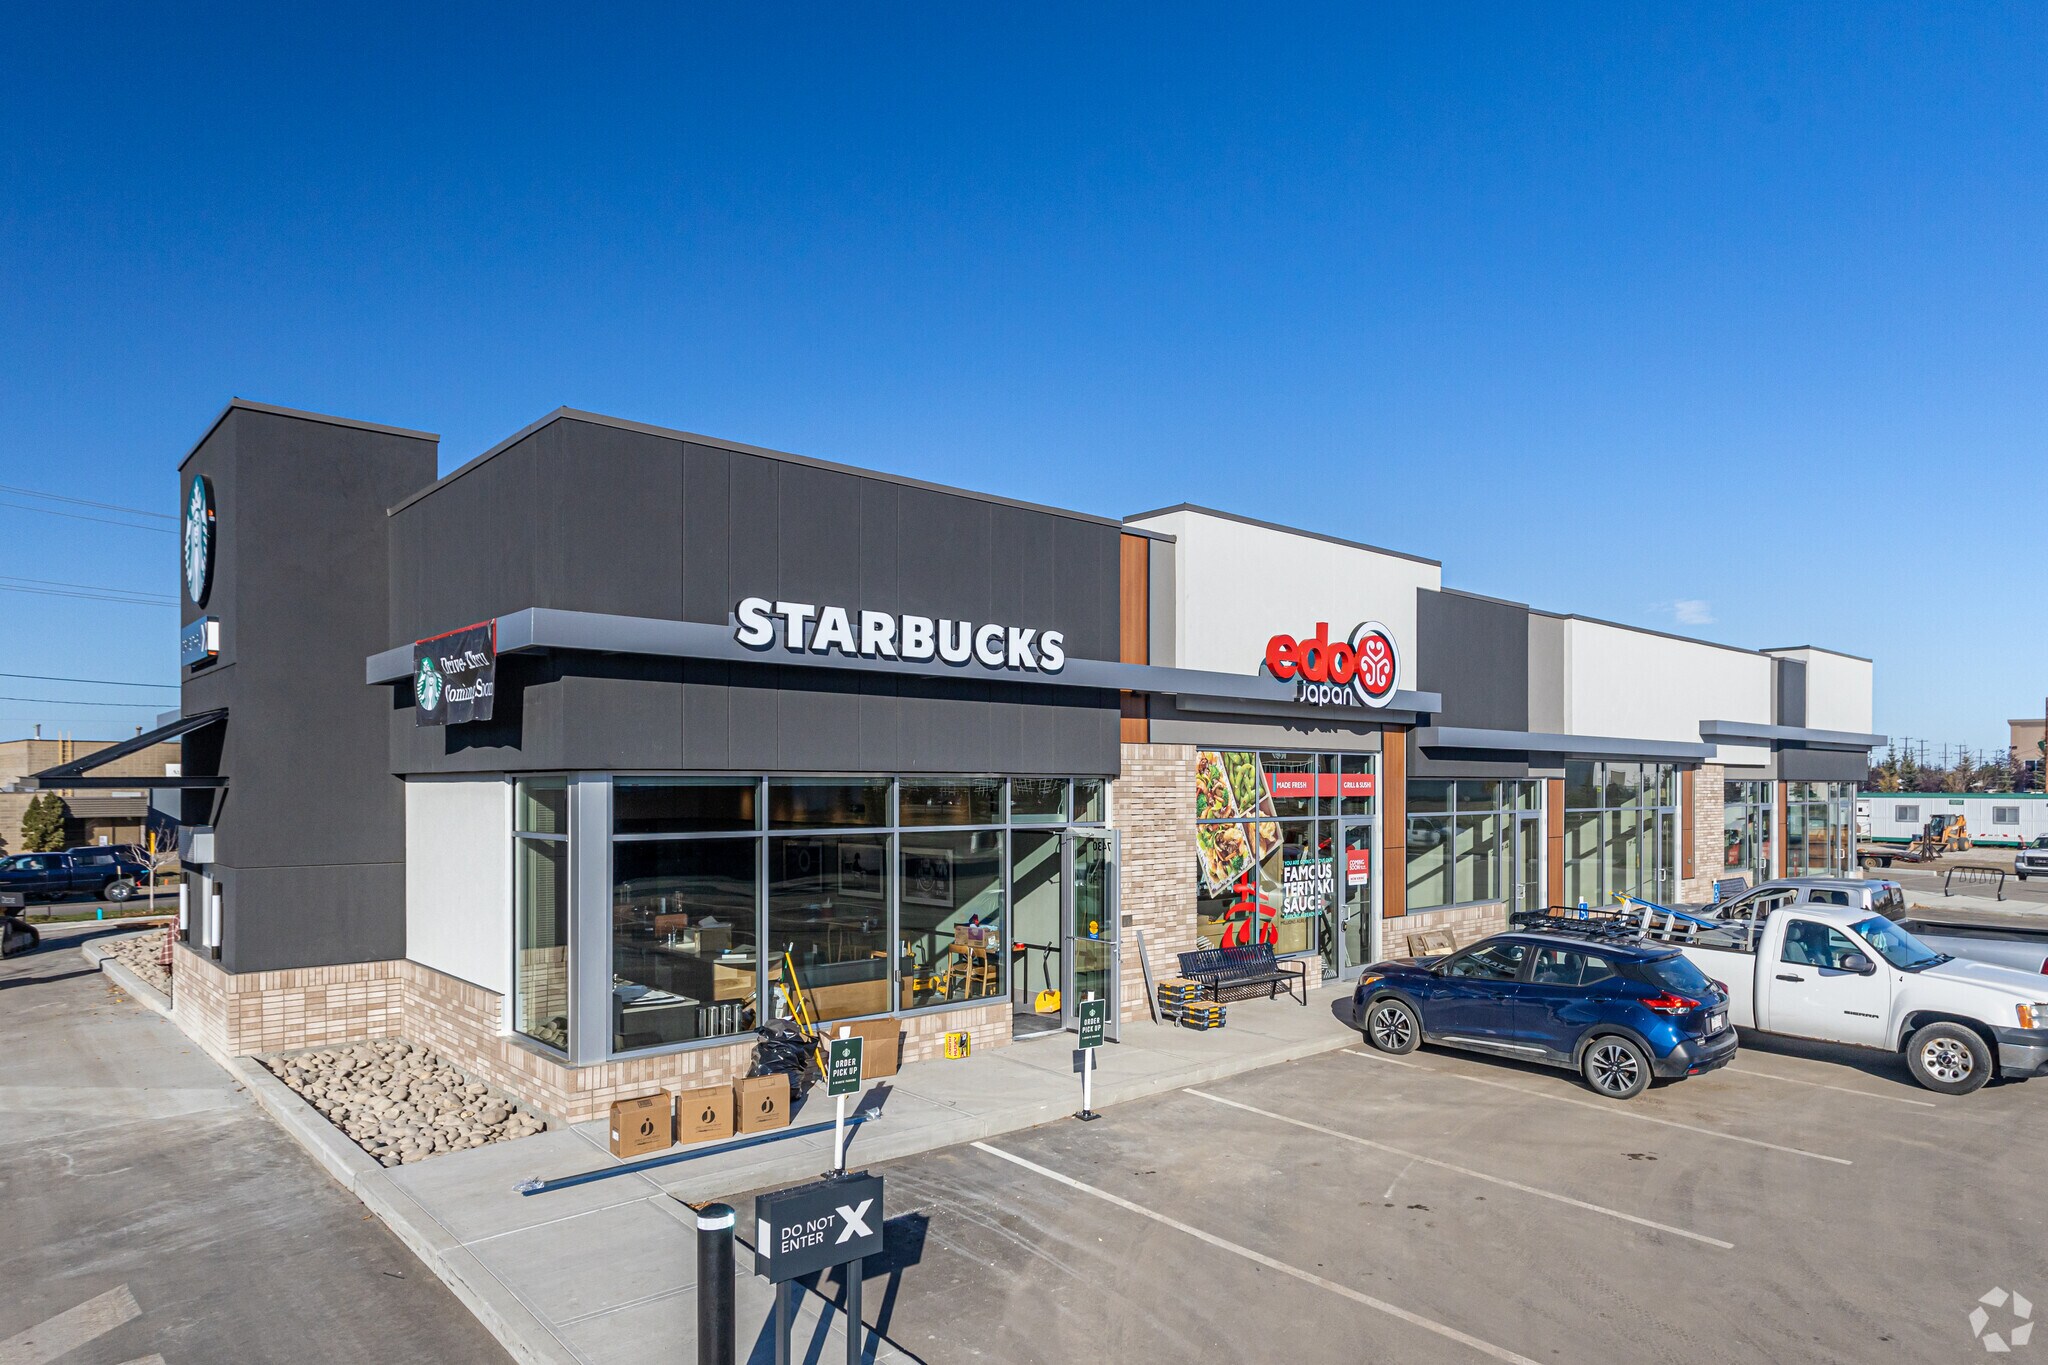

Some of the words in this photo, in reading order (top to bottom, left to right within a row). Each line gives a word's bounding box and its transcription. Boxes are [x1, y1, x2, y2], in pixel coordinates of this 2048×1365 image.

[734, 597, 1065, 673] STARBUCKS
[440, 650, 490, 674] Drive-Thru
[1265, 622, 1355, 684] edo
[445, 683, 475, 704] Coming
[475, 678, 493, 698] Soon
[1300, 680, 1353, 707] japan
[1276, 781, 1291, 789] MADE
[1292, 781, 1307, 789] FRESH
[1343, 781, 1355, 789] GRILL
[1359, 781, 1372, 789] SUSHI
[1283, 879, 1334, 898] TERIYAKI
[1084, 1017, 1100, 1025] ORDER
[1843, 1010, 1879, 1019] SIERRA
[833, 1068, 847, 1077] PICK
[849, 1067, 857, 1075] UP
[835, 1058, 856, 1068] ORDER
[781, 1223, 803, 1240] DO
[806, 1215, 835, 1233] NOT
[781, 1232, 824, 1254] ENTER
